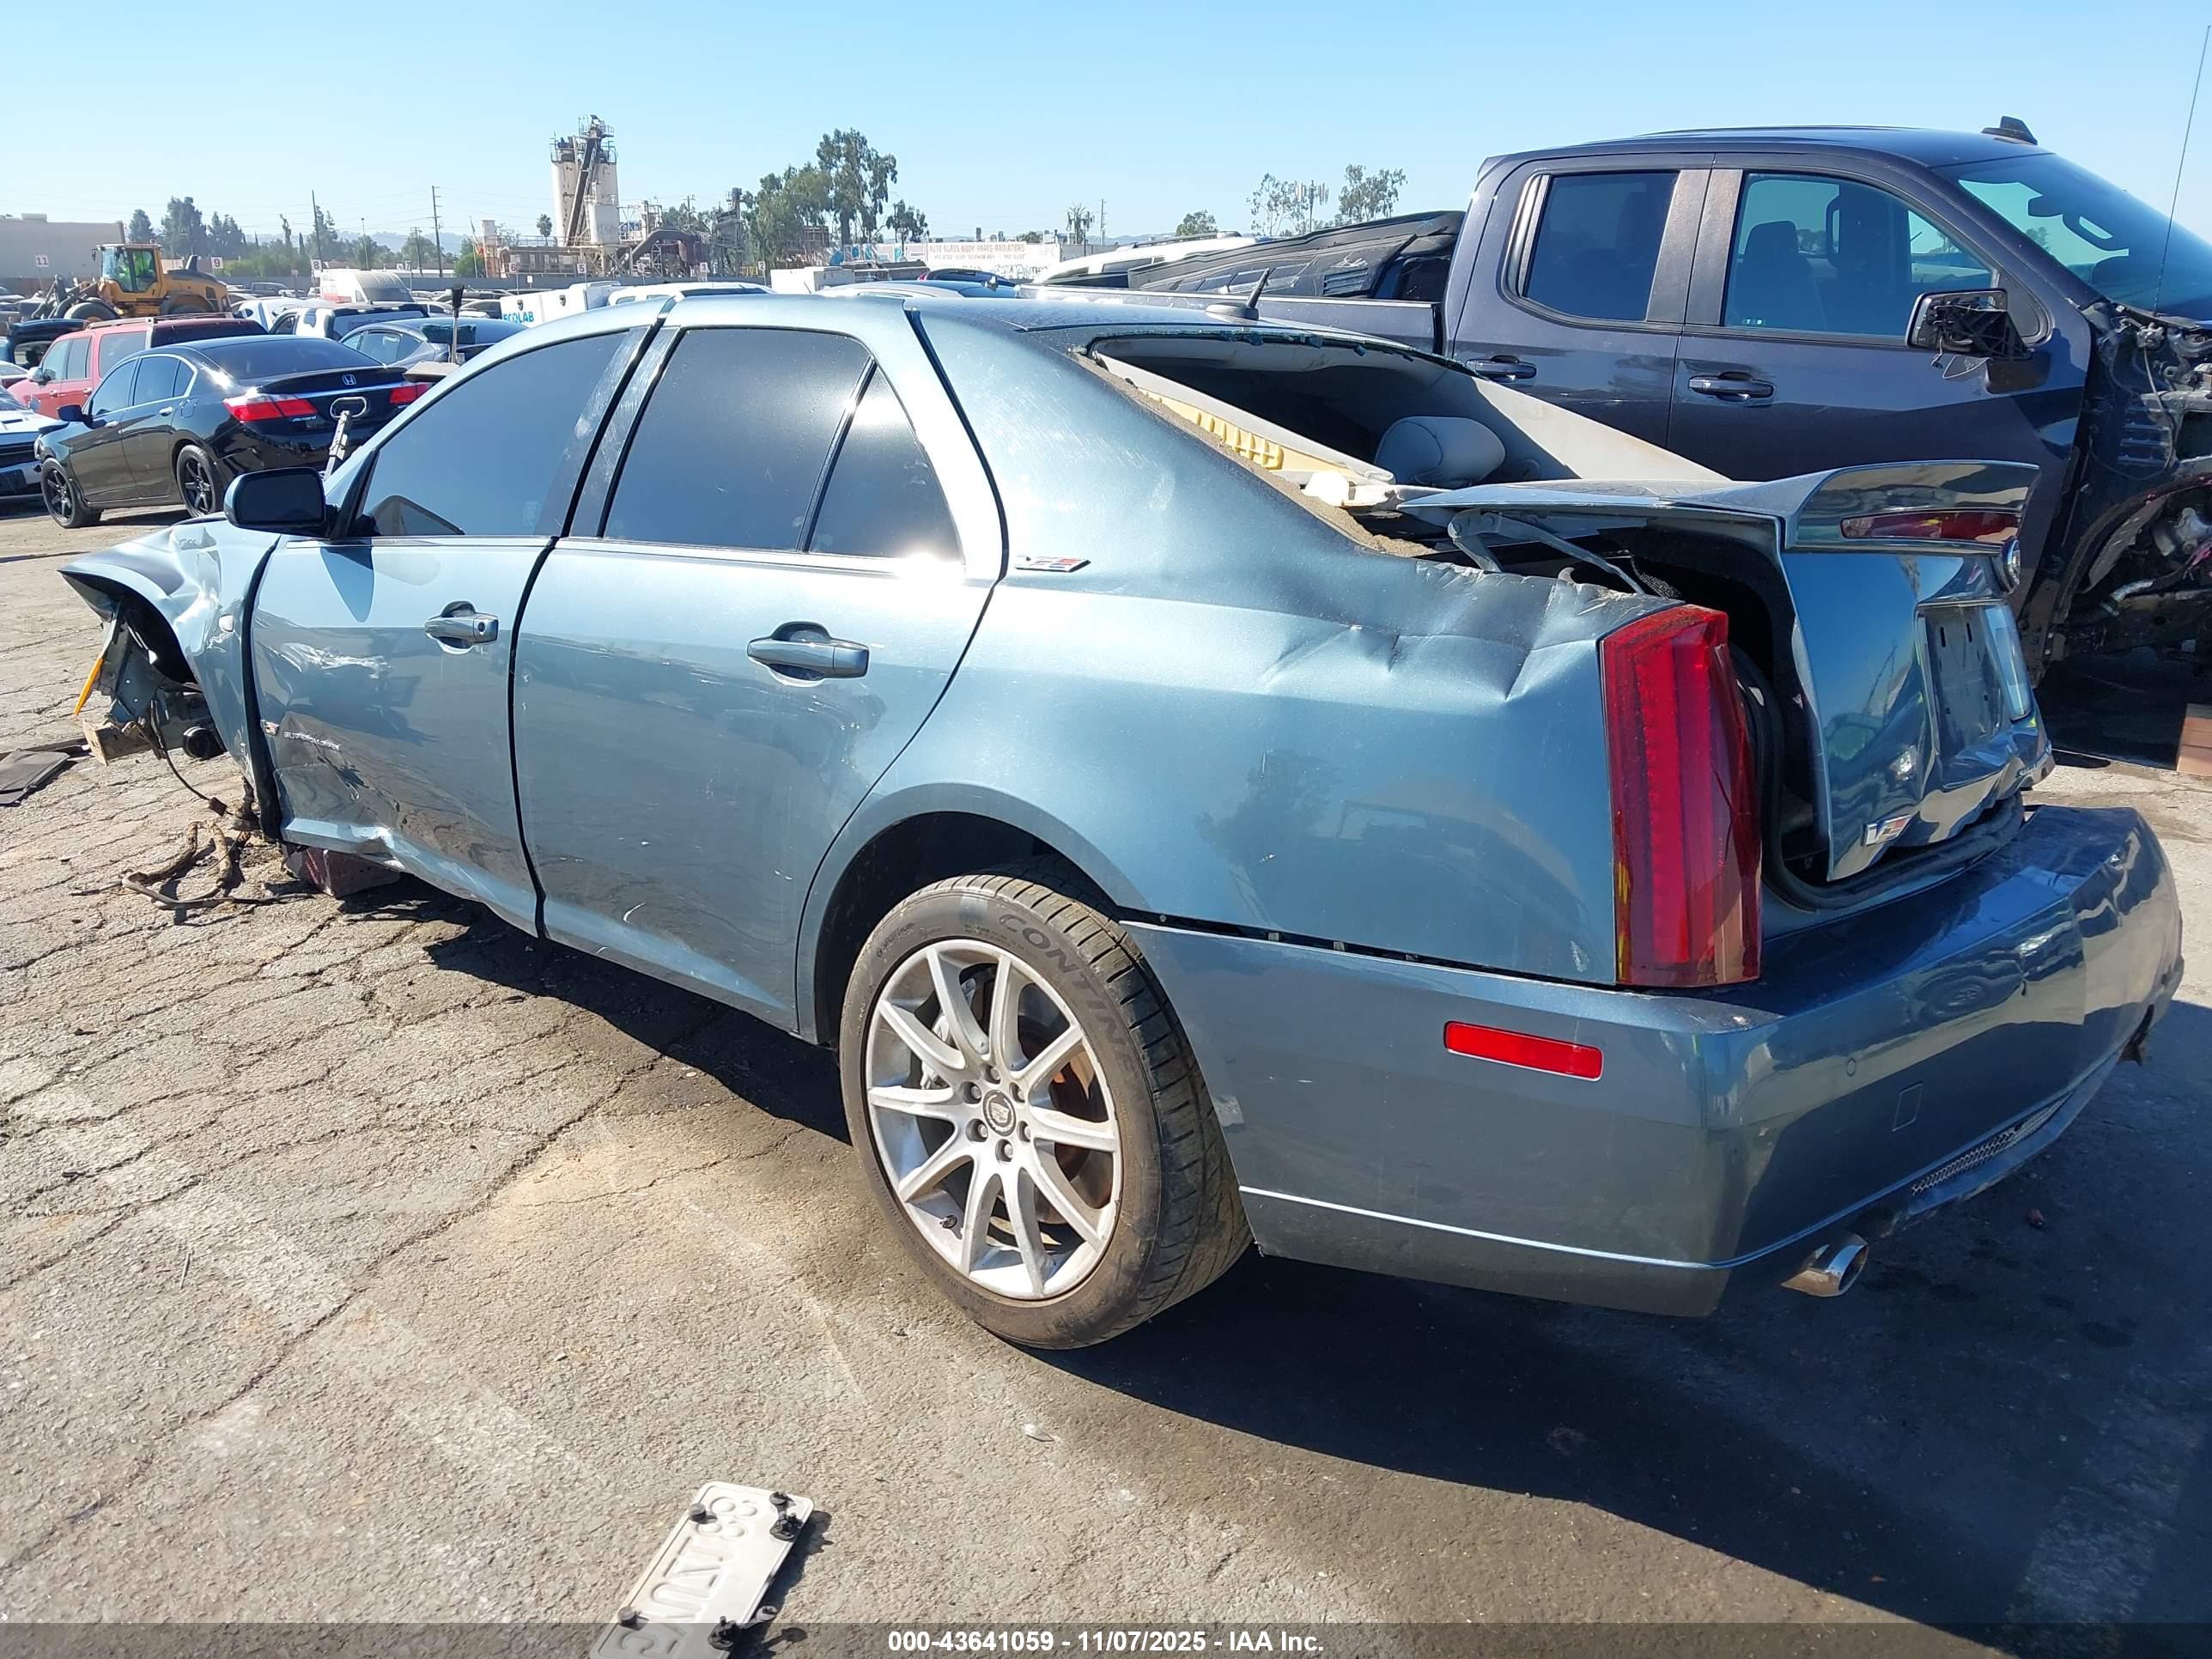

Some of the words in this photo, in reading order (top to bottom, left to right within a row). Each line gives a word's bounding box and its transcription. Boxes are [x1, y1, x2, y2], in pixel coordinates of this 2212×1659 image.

[36, 257, 48, 265] 11
[214, 258, 221, 268] 9
[313, 260, 319, 270] 8
[503, 312, 534, 324] ECOLAB
